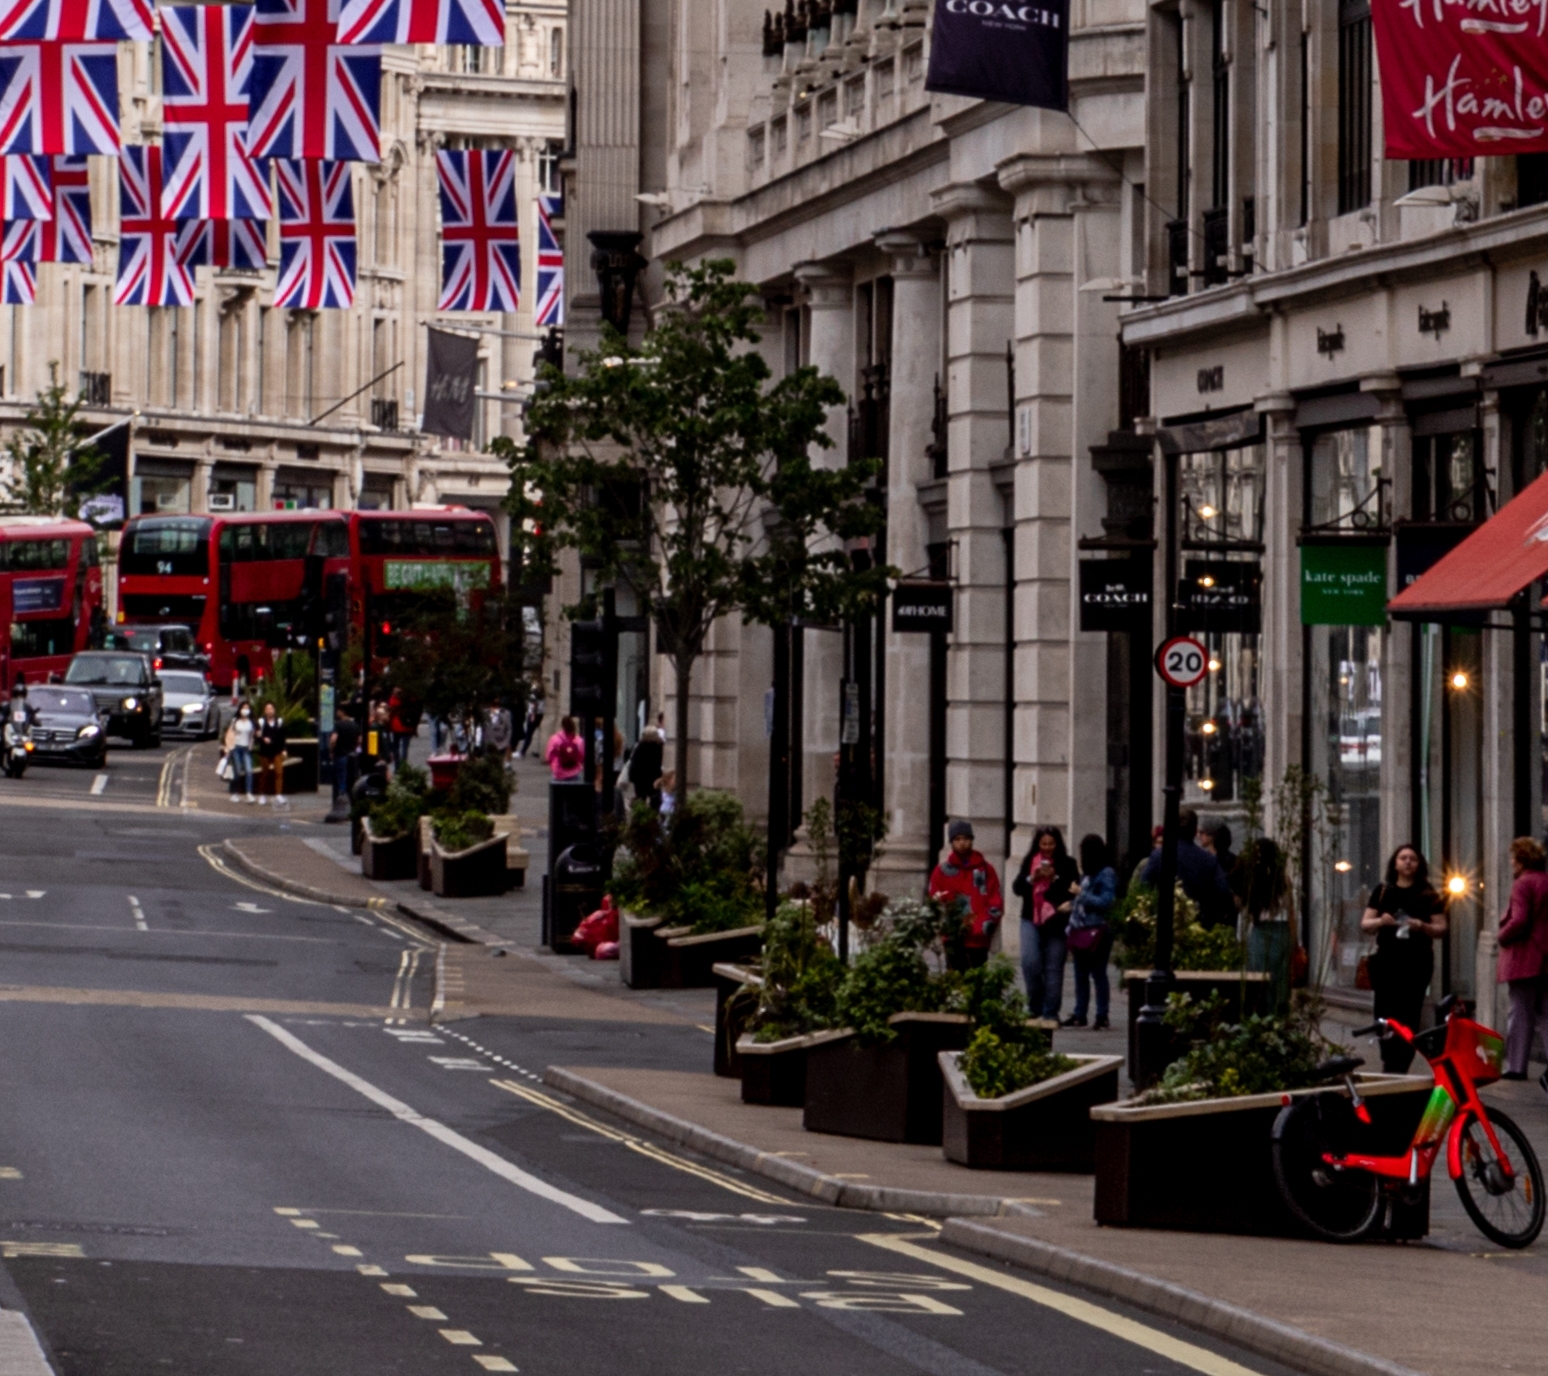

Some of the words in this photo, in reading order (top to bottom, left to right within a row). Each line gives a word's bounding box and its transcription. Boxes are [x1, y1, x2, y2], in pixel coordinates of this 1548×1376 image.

[157, 560, 172, 575] 94
[1304, 569, 1336, 583] kate
[1340, 571, 1381, 587] spade
[1083, 593, 1148, 603] COACH
[1168, 652, 1202, 673] 20
